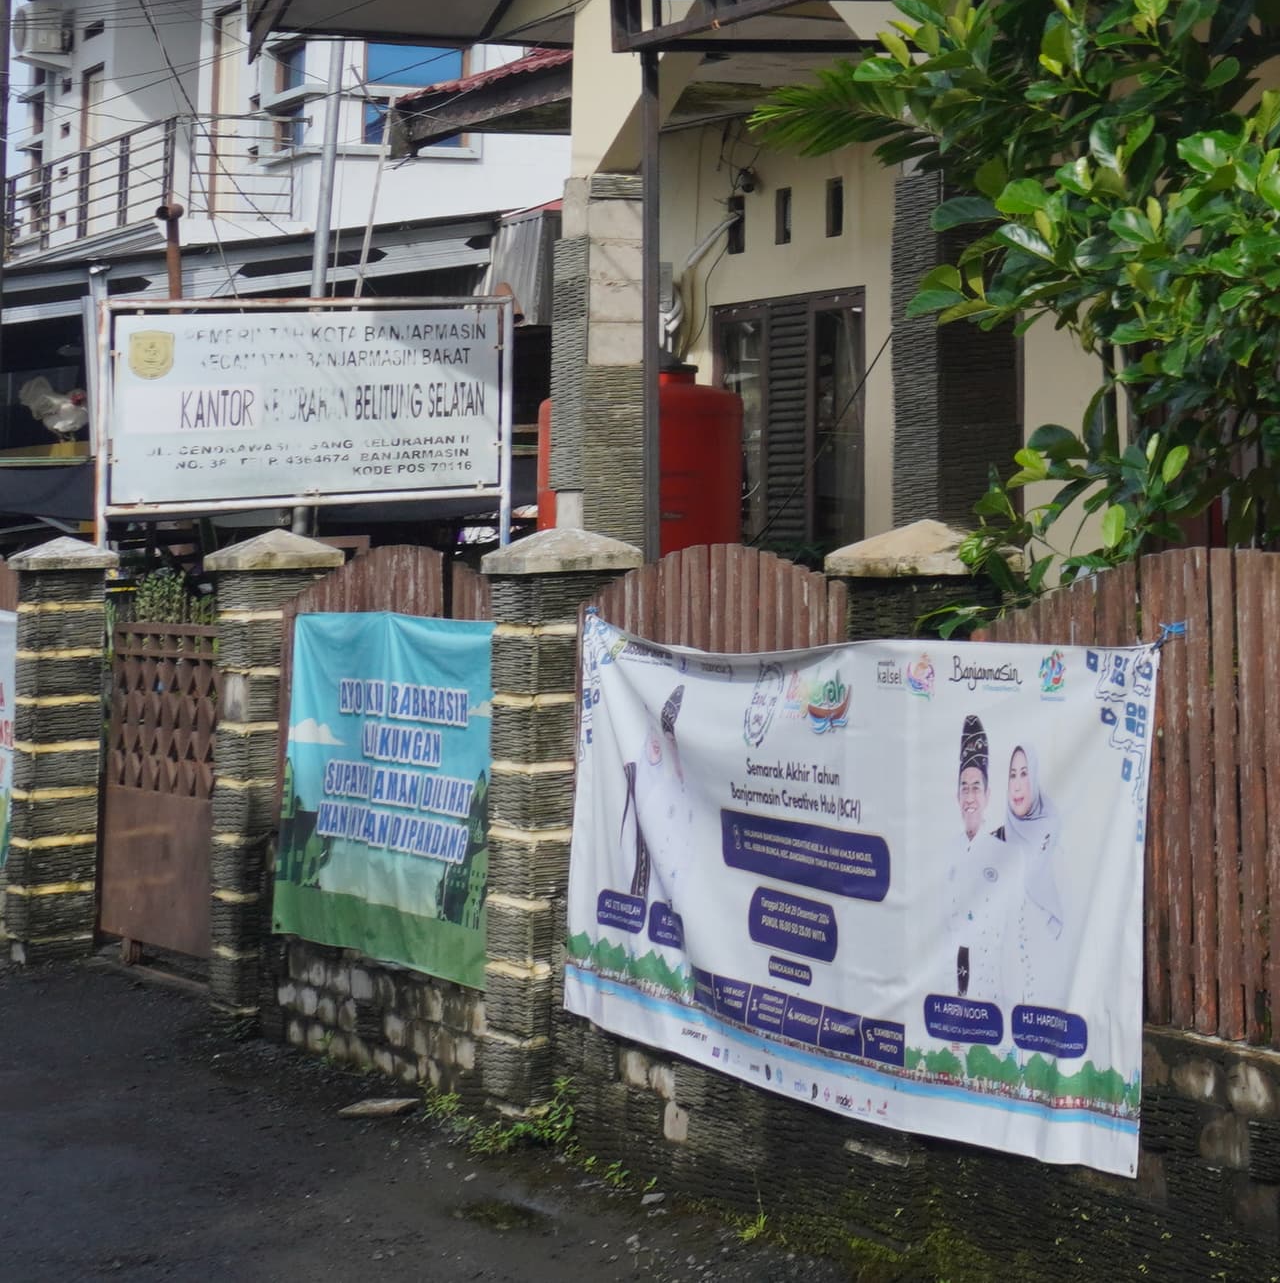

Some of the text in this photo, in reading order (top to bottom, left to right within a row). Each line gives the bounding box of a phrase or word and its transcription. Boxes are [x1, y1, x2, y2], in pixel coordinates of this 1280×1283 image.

[364, 323, 487, 343] BANJARMASIN
[422, 348, 471, 366] BARAT
[180, 389, 255, 429] KANTOR
[355, 383, 423, 421] BELITUNG
[428, 381, 486, 418] SELATAN
[360, 448, 470, 462] BANJARMASIN
[365, 436, 455, 449] ELURAHAN
[352, 465, 393, 476] KODE
[397, 463, 426, 474] POS
[341, 679, 363, 712] AYO
[364, 722, 441, 764] LIKUNGAN
[746, 757, 840, 786] Semarak Akhir Tahun
[422, 776, 475, 816] DILIHAT
[730, 781, 861, 824] Banjarmasin Creative Hub (BCH)
[391, 815, 469, 862] DIPANDANG
[964, 1006, 989, 1020] NOOR
